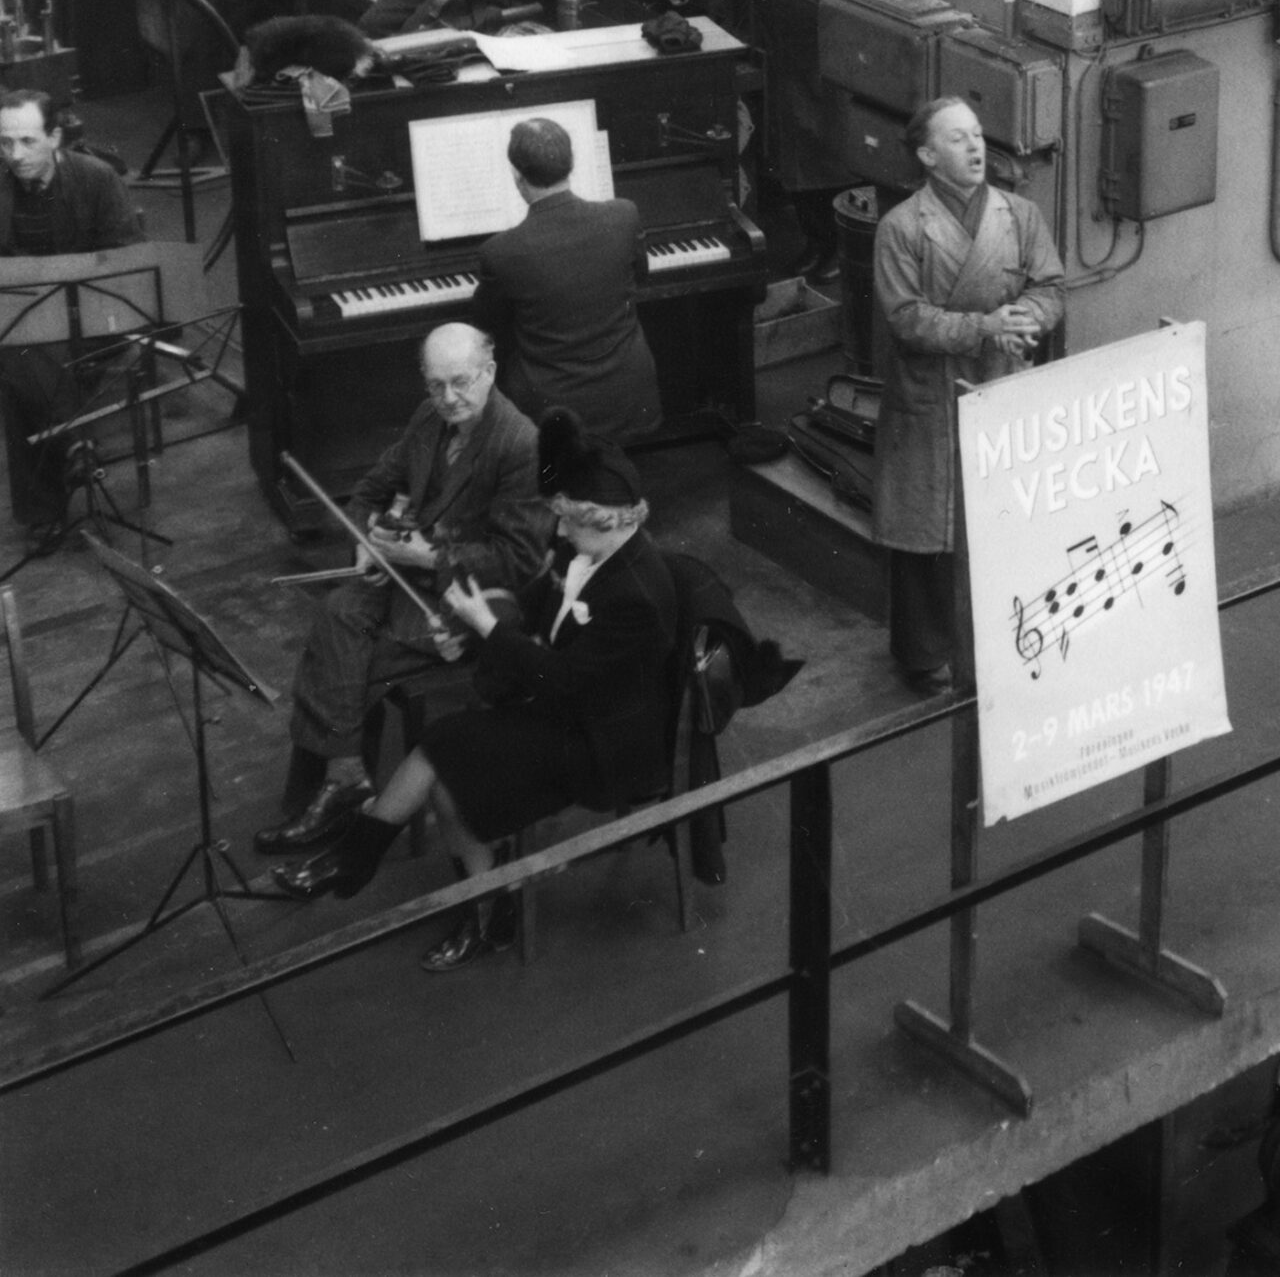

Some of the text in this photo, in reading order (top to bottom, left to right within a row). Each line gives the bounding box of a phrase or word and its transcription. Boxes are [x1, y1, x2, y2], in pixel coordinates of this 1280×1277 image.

[977, 365, 1193, 480] MUSIKENS
[1012, 435, 1162, 522] VECKA
[1067, 685, 1135, 738] MARS
[1143, 661, 1195, 707] 1947
